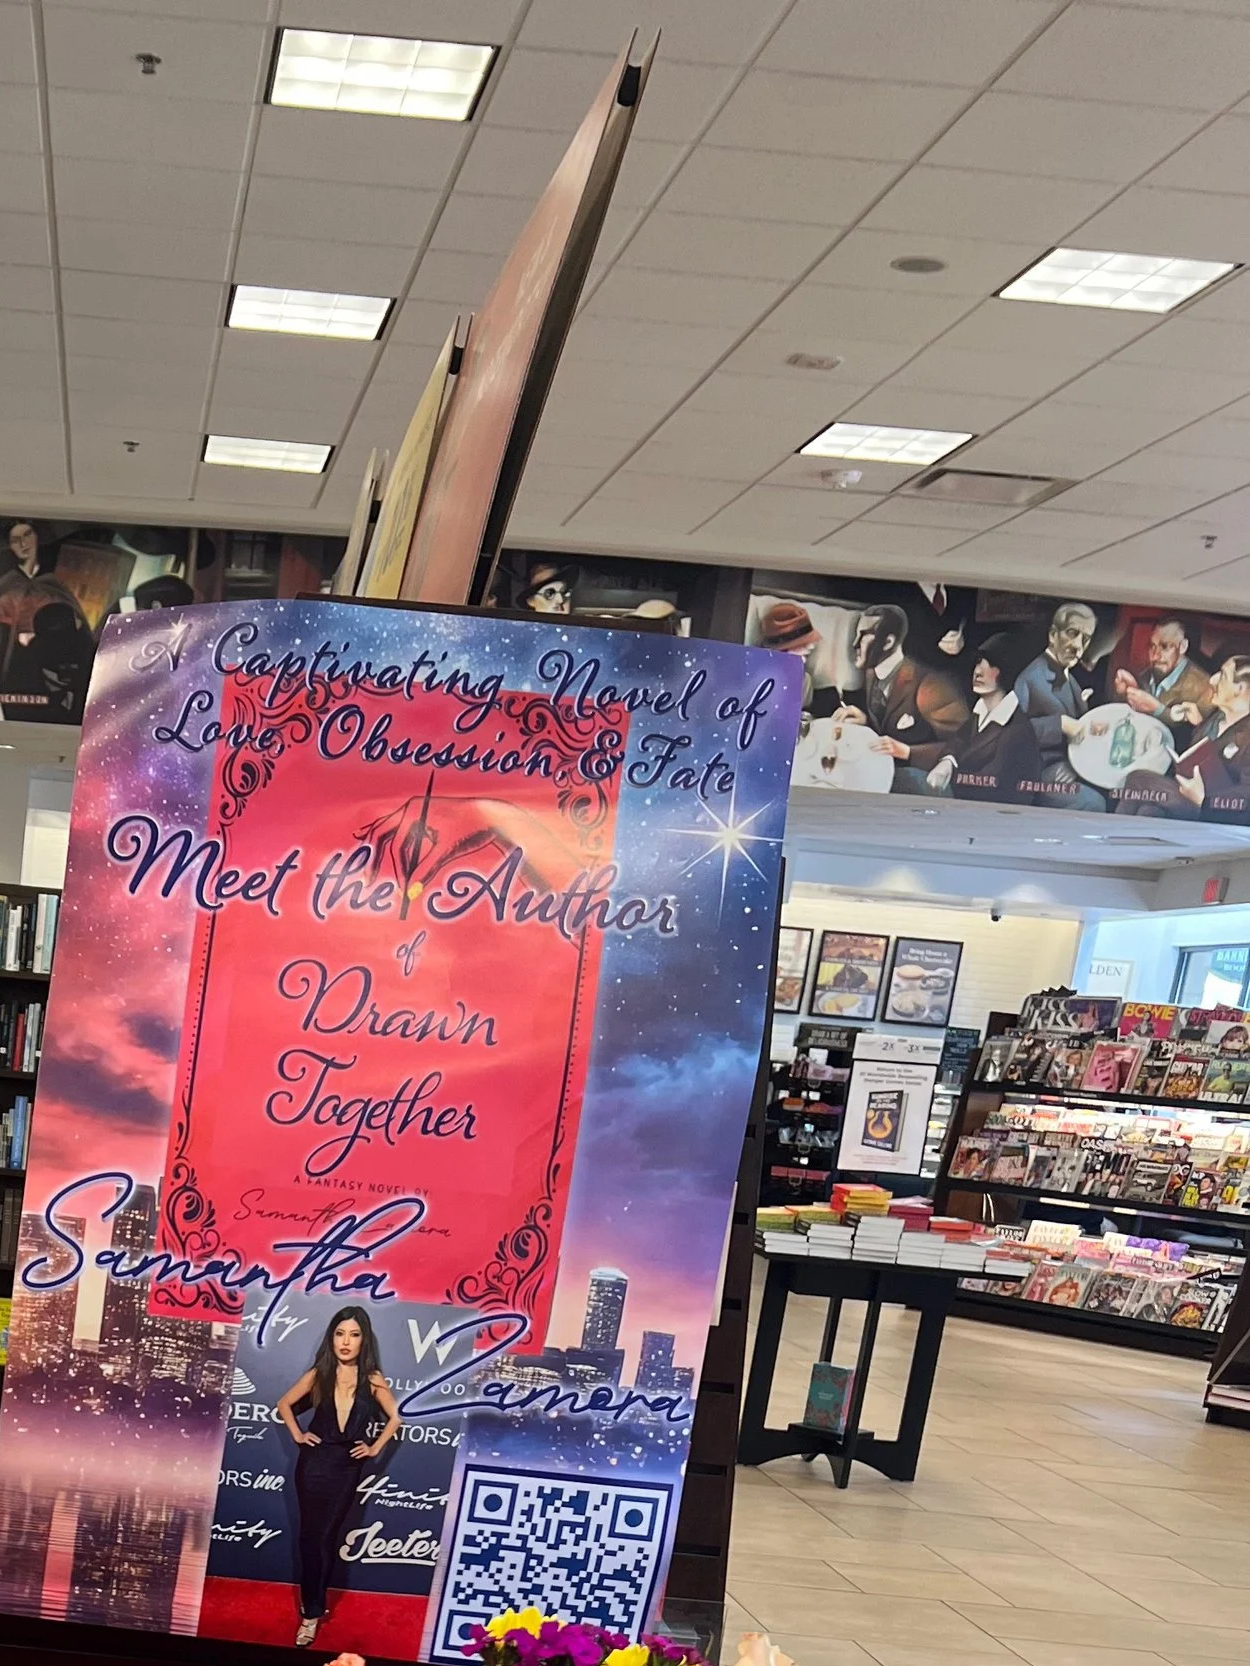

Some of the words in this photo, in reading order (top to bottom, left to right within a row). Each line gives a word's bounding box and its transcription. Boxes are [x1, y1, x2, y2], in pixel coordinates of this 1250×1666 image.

[128, 622, 186, 676] A
[213, 621, 504, 732] Captivating
[538, 648, 692, 721] Novel
[718, 678, 776, 751] of
[152, 689, 288, 758] Love,
[320, 703, 572, 782] Obsession,
[578, 729, 627, 781] &
[622, 735, 739, 801] Fate
[955, 772, 998, 788] PARKER
[1018, 779, 1078, 795] FAULKNER
[1212, 795, 1247, 812] ELIOT
[107, 816, 299, 912] Meet
[312, 845, 398, 919] the
[427, 847, 679, 943] Author
[395, 929, 426, 978] of
[277, 957, 500, 1048] Drawn
[1124, 1004, 1176, 1021] BOWIE
[264, 1047, 480, 1178] Together
[22, 1172, 427, 1345] Samantha
[338, 1520, 441, 1563] Jeeter
